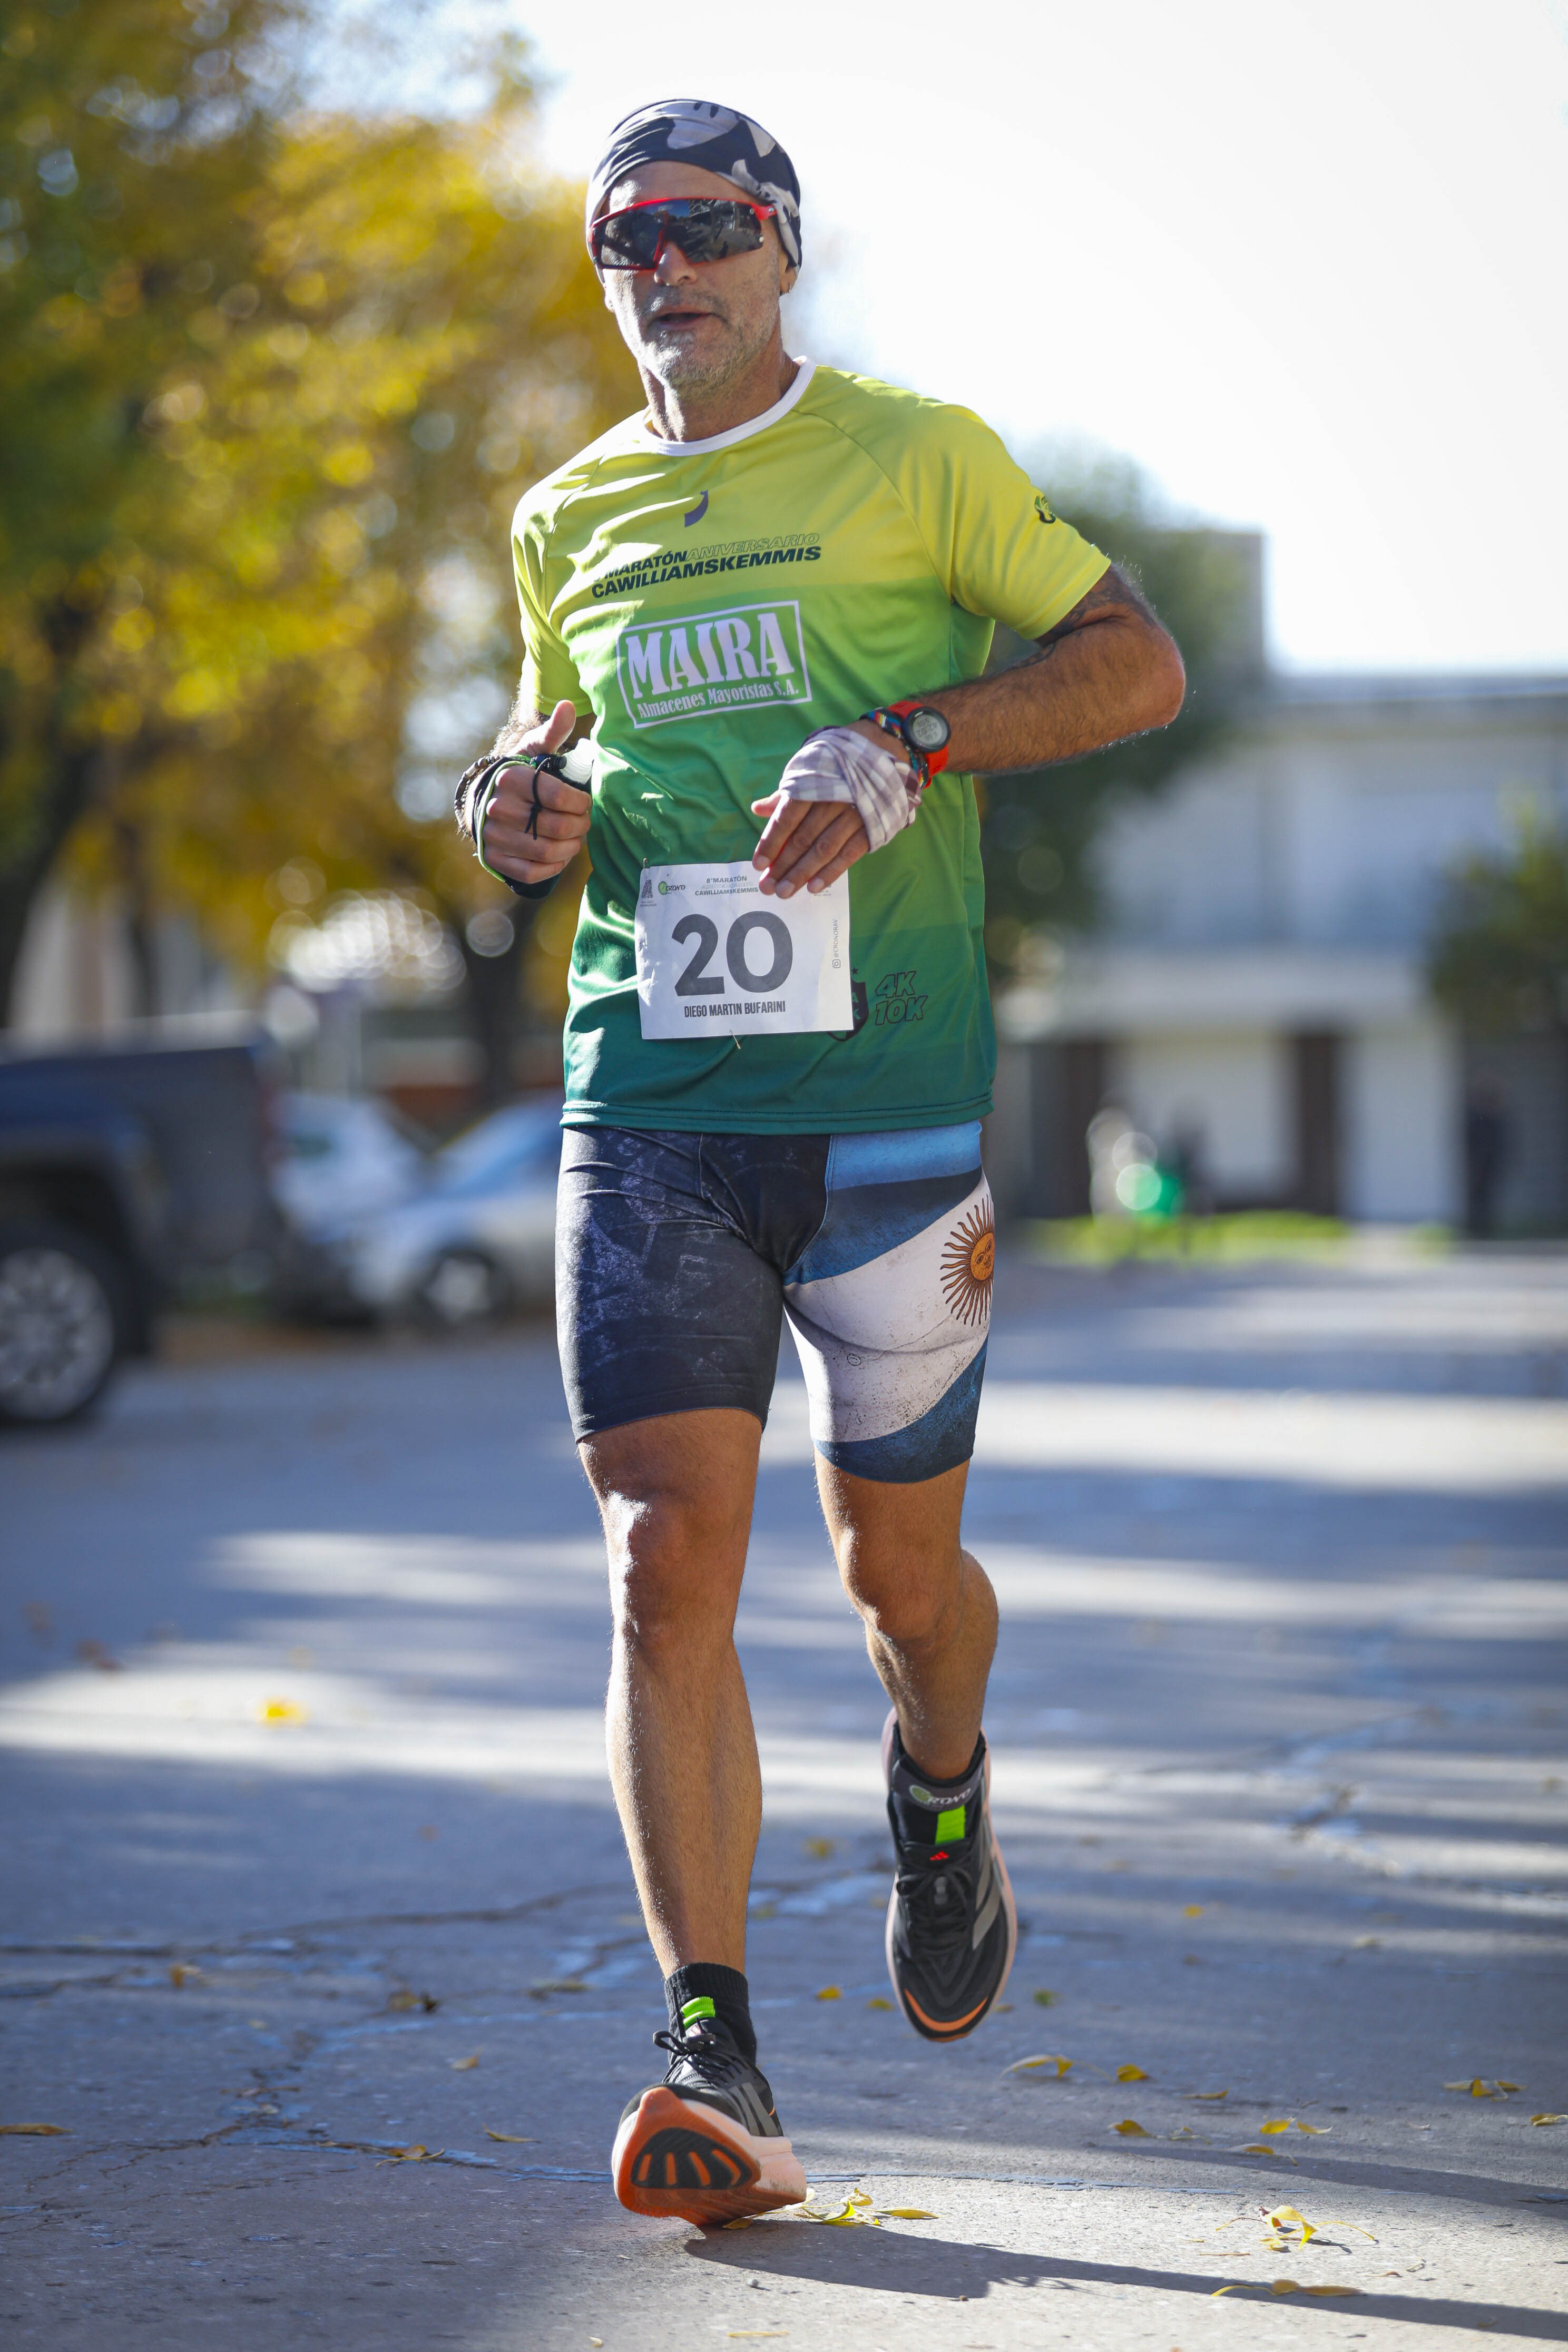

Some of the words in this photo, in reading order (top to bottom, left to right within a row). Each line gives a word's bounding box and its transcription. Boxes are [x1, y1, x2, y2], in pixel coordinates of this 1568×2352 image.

[685, 533, 819, 561] ANIVERSARIO
[591, 546, 821, 599] CAWILLIAMSKEMMIS
[625, 612, 795, 699] MAIRA
[636, 692, 705, 719] Almacenes
[707, 682, 774, 705] Mayoristas
[774, 679, 799, 696] S.A.
[695, 887, 759, 896] CAWILLIAMSKEMMIS
[671, 910, 793, 997] 20
[875, 971, 917, 998] 4K
[684, 1005, 708, 1017] DIEGO
[709, 1003, 742, 1016] MARTIN
[744, 1001, 786, 1014] BUFARINI
[875, 995, 928, 1025] 10K
